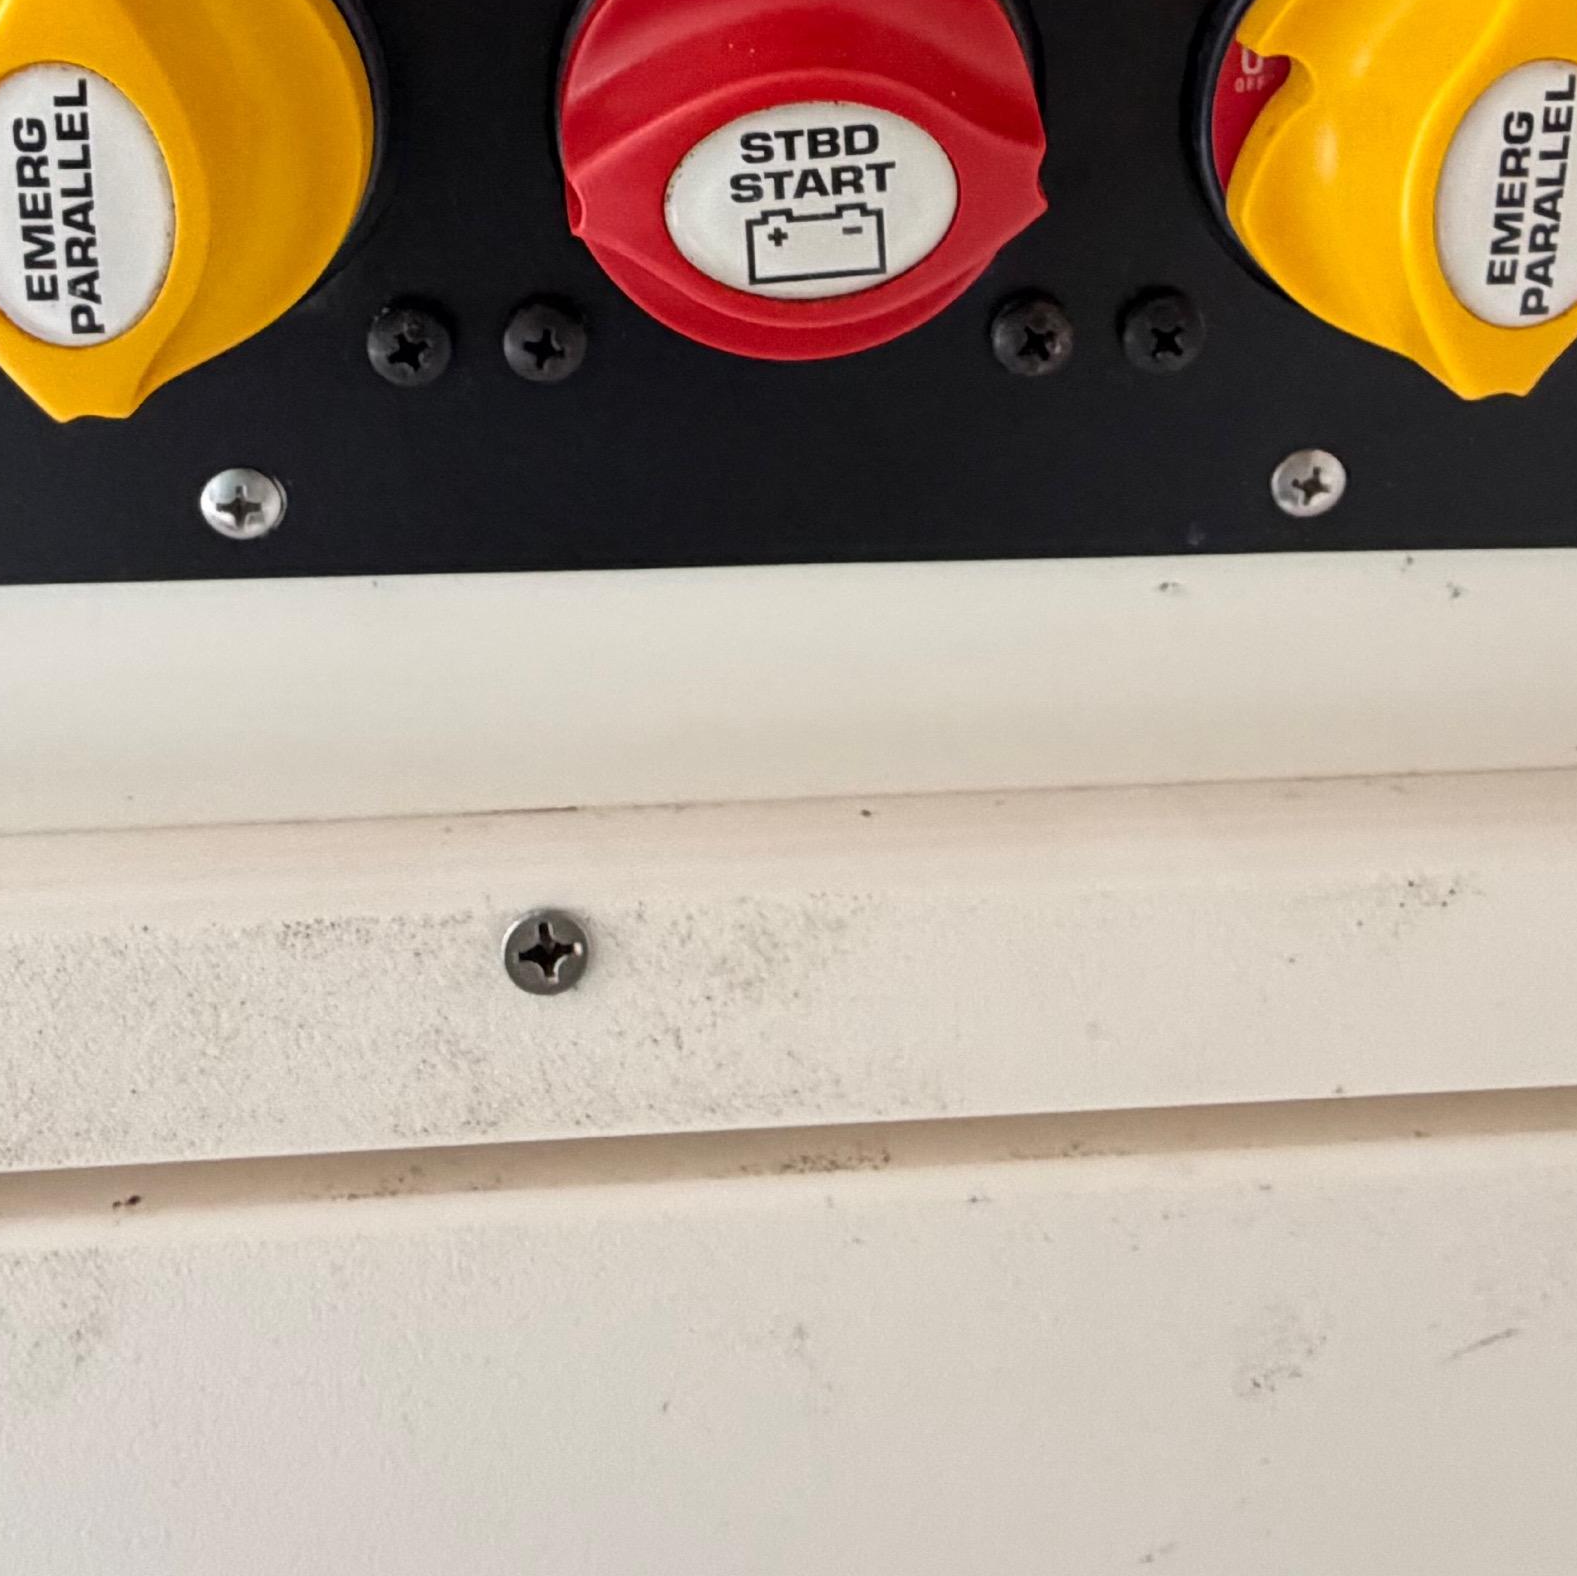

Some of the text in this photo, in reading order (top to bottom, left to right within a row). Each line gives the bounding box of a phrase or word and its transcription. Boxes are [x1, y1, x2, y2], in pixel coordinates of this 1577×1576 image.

[12, 115, 61, 303] EMERG
[53, 78, 106, 335] PARALLEL
[730, 161, 896, 205] START
[739, 124, 879, 165] STBD
[1486, 110, 1535, 286] EMERG
[1519, 73, 1576, 317] PARALLEL
